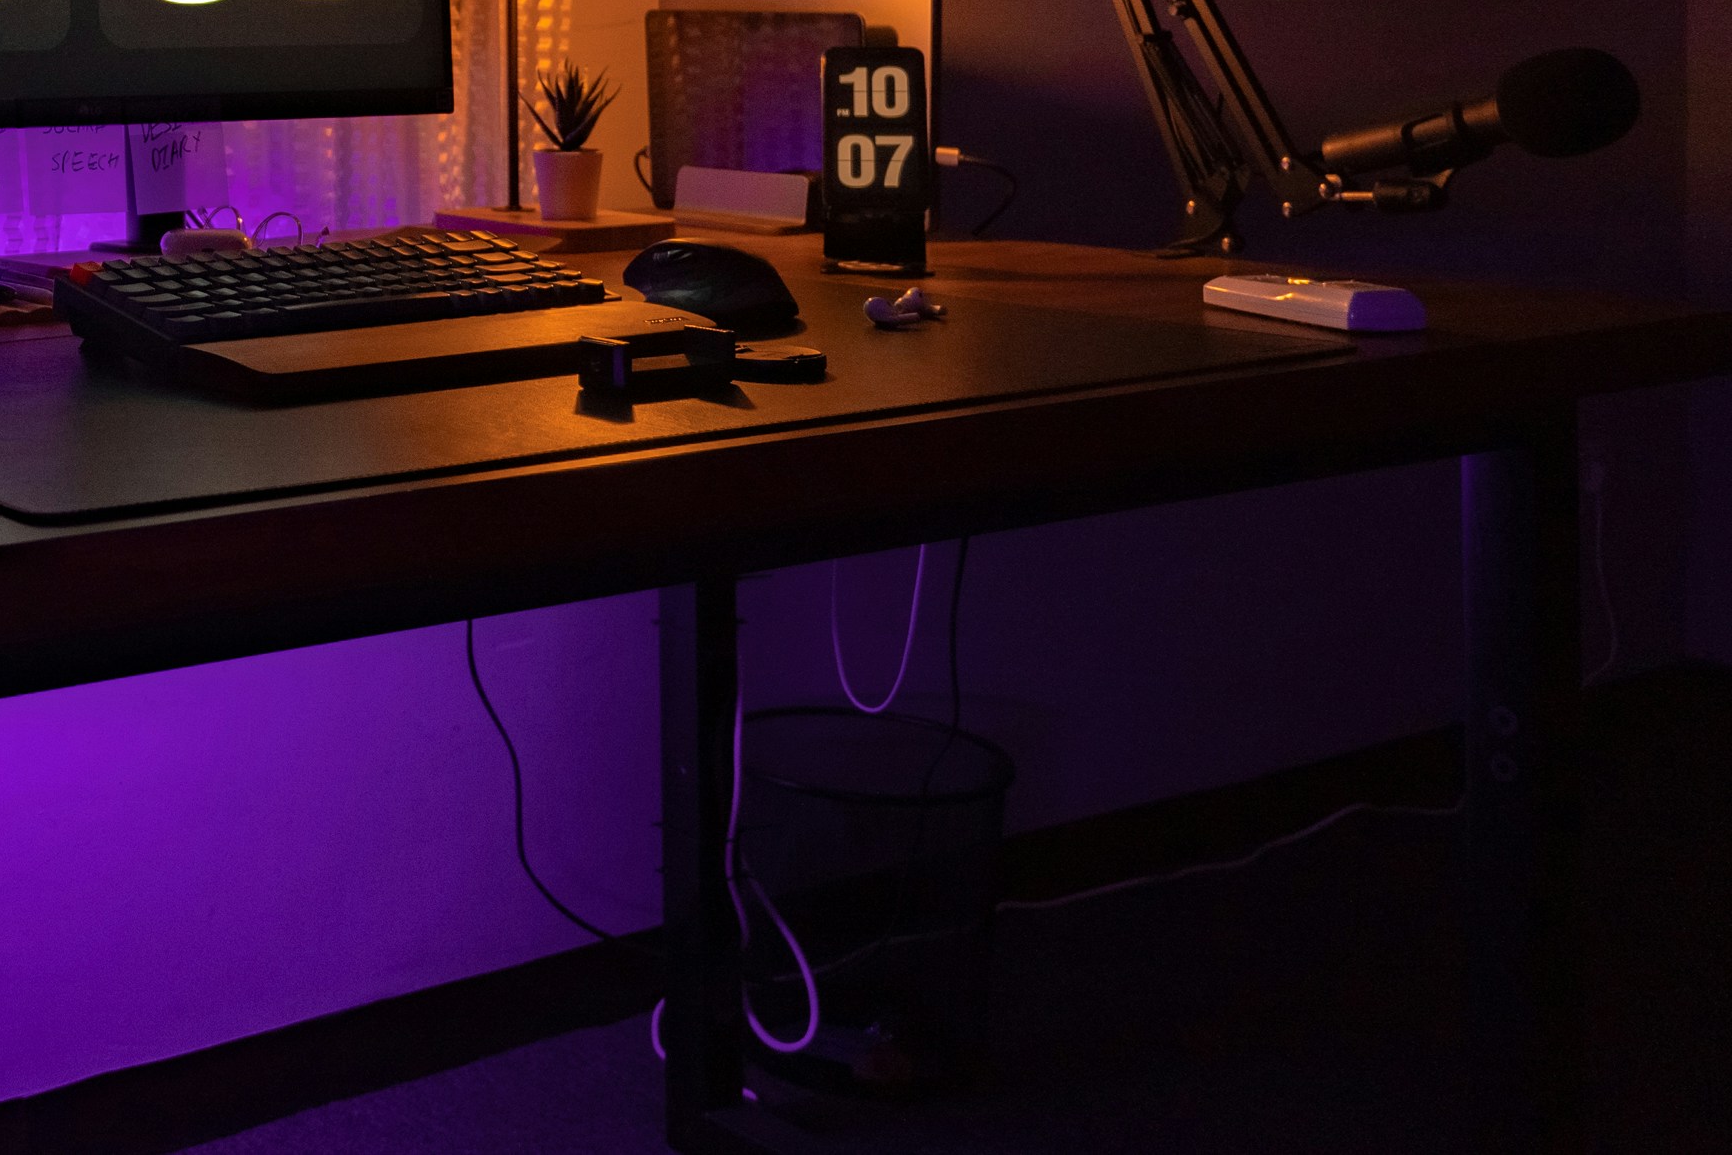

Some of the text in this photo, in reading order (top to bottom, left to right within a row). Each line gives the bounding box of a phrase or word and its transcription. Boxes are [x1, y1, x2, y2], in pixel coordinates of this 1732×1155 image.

[837, 108, 850, 117] PM
[838, 66, 909, 118] 10
[51, 149, 120, 174] SPEECH
[150, 130, 202, 173] DIARY
[837, 134, 914, 188] 07
